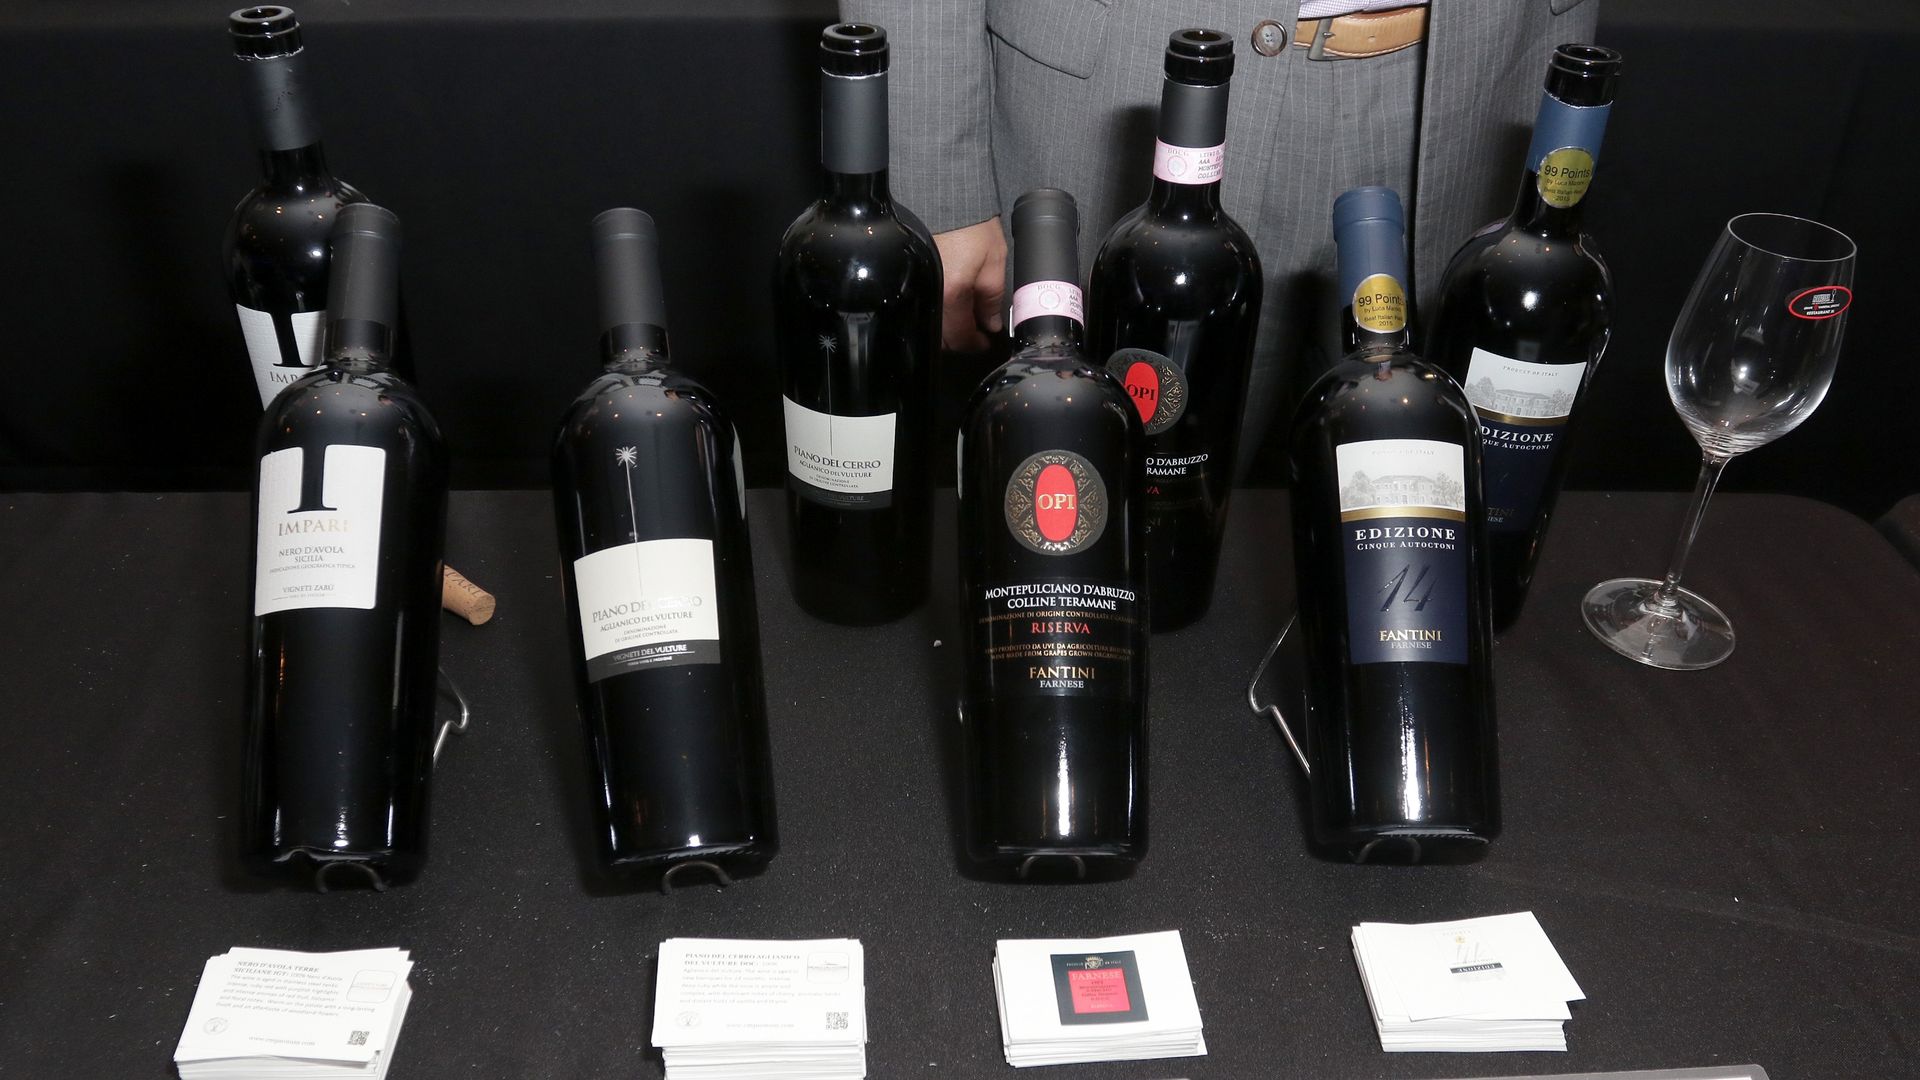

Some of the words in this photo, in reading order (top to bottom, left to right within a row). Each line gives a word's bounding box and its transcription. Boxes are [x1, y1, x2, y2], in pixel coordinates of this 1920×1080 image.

[1544, 165, 1558, 176] 99
[1561, 167, 1591, 178] Points
[1358, 295, 1372, 307] 99
[269, 371, 299, 385] IMP
[1126, 383, 1156, 401] OPI
[1480, 426, 1554, 442] DIZIONE
[1482, 438, 1499, 447] QUE
[793, 445, 821, 464] PIANO
[822, 456, 840, 468] DEL
[842, 459, 881, 469] CERRO
[1156, 453, 1209, 466] D'ABRUZZO
[1146, 466, 1187, 476] RAMANE
[1038, 493, 1075, 510] OPI
[1355, 526, 1456, 541] EDIZIONE
[279, 547, 302, 557] NERO
[304, 545, 345, 555] D'AVOLA
[294, 555, 324, 563] SICILIA
[282, 585, 312, 593] VIGNETI
[985, 583, 1081, 600] MONTEPULCIANO
[1083, 584, 1135, 602] D'ABRUZZO
[1377, 563, 1440, 613] 14
[1007, 597, 1056, 609] COLLINE
[1059, 597, 1116, 611] TERAMANE
[592, 603, 628, 624] PIANO
[1035, 610, 1065, 618] ORIGINE
[599, 616, 641, 632] AGLIANICO
[642, 615, 654, 623] DEL
[655, 610, 693, 621] VULTURE
[1031, 621, 1091, 634] RISERVA
[1379, 628, 1443, 642] FANTINI
[998, 644, 1031, 652] PRODOTTO
[1056, 642, 1066, 650] DA
[1066, 643, 1109, 652] AGRICOLTURA
[1391, 640, 1432, 650] FARNESE
[612, 650, 640, 661] VIGNETI
[640, 647, 655, 656] DEL
[655, 644, 688, 654] VULTURE
[1043, 649, 1068, 657] GRAPES
[1068, 649, 1093, 657] GROWN
[1029, 666, 1095, 680] FANTINI
[1039, 679, 1084, 689] FARNESE
[294, 965, 320, 973] TERRE
[1071, 971, 1121, 981] FARNESE
